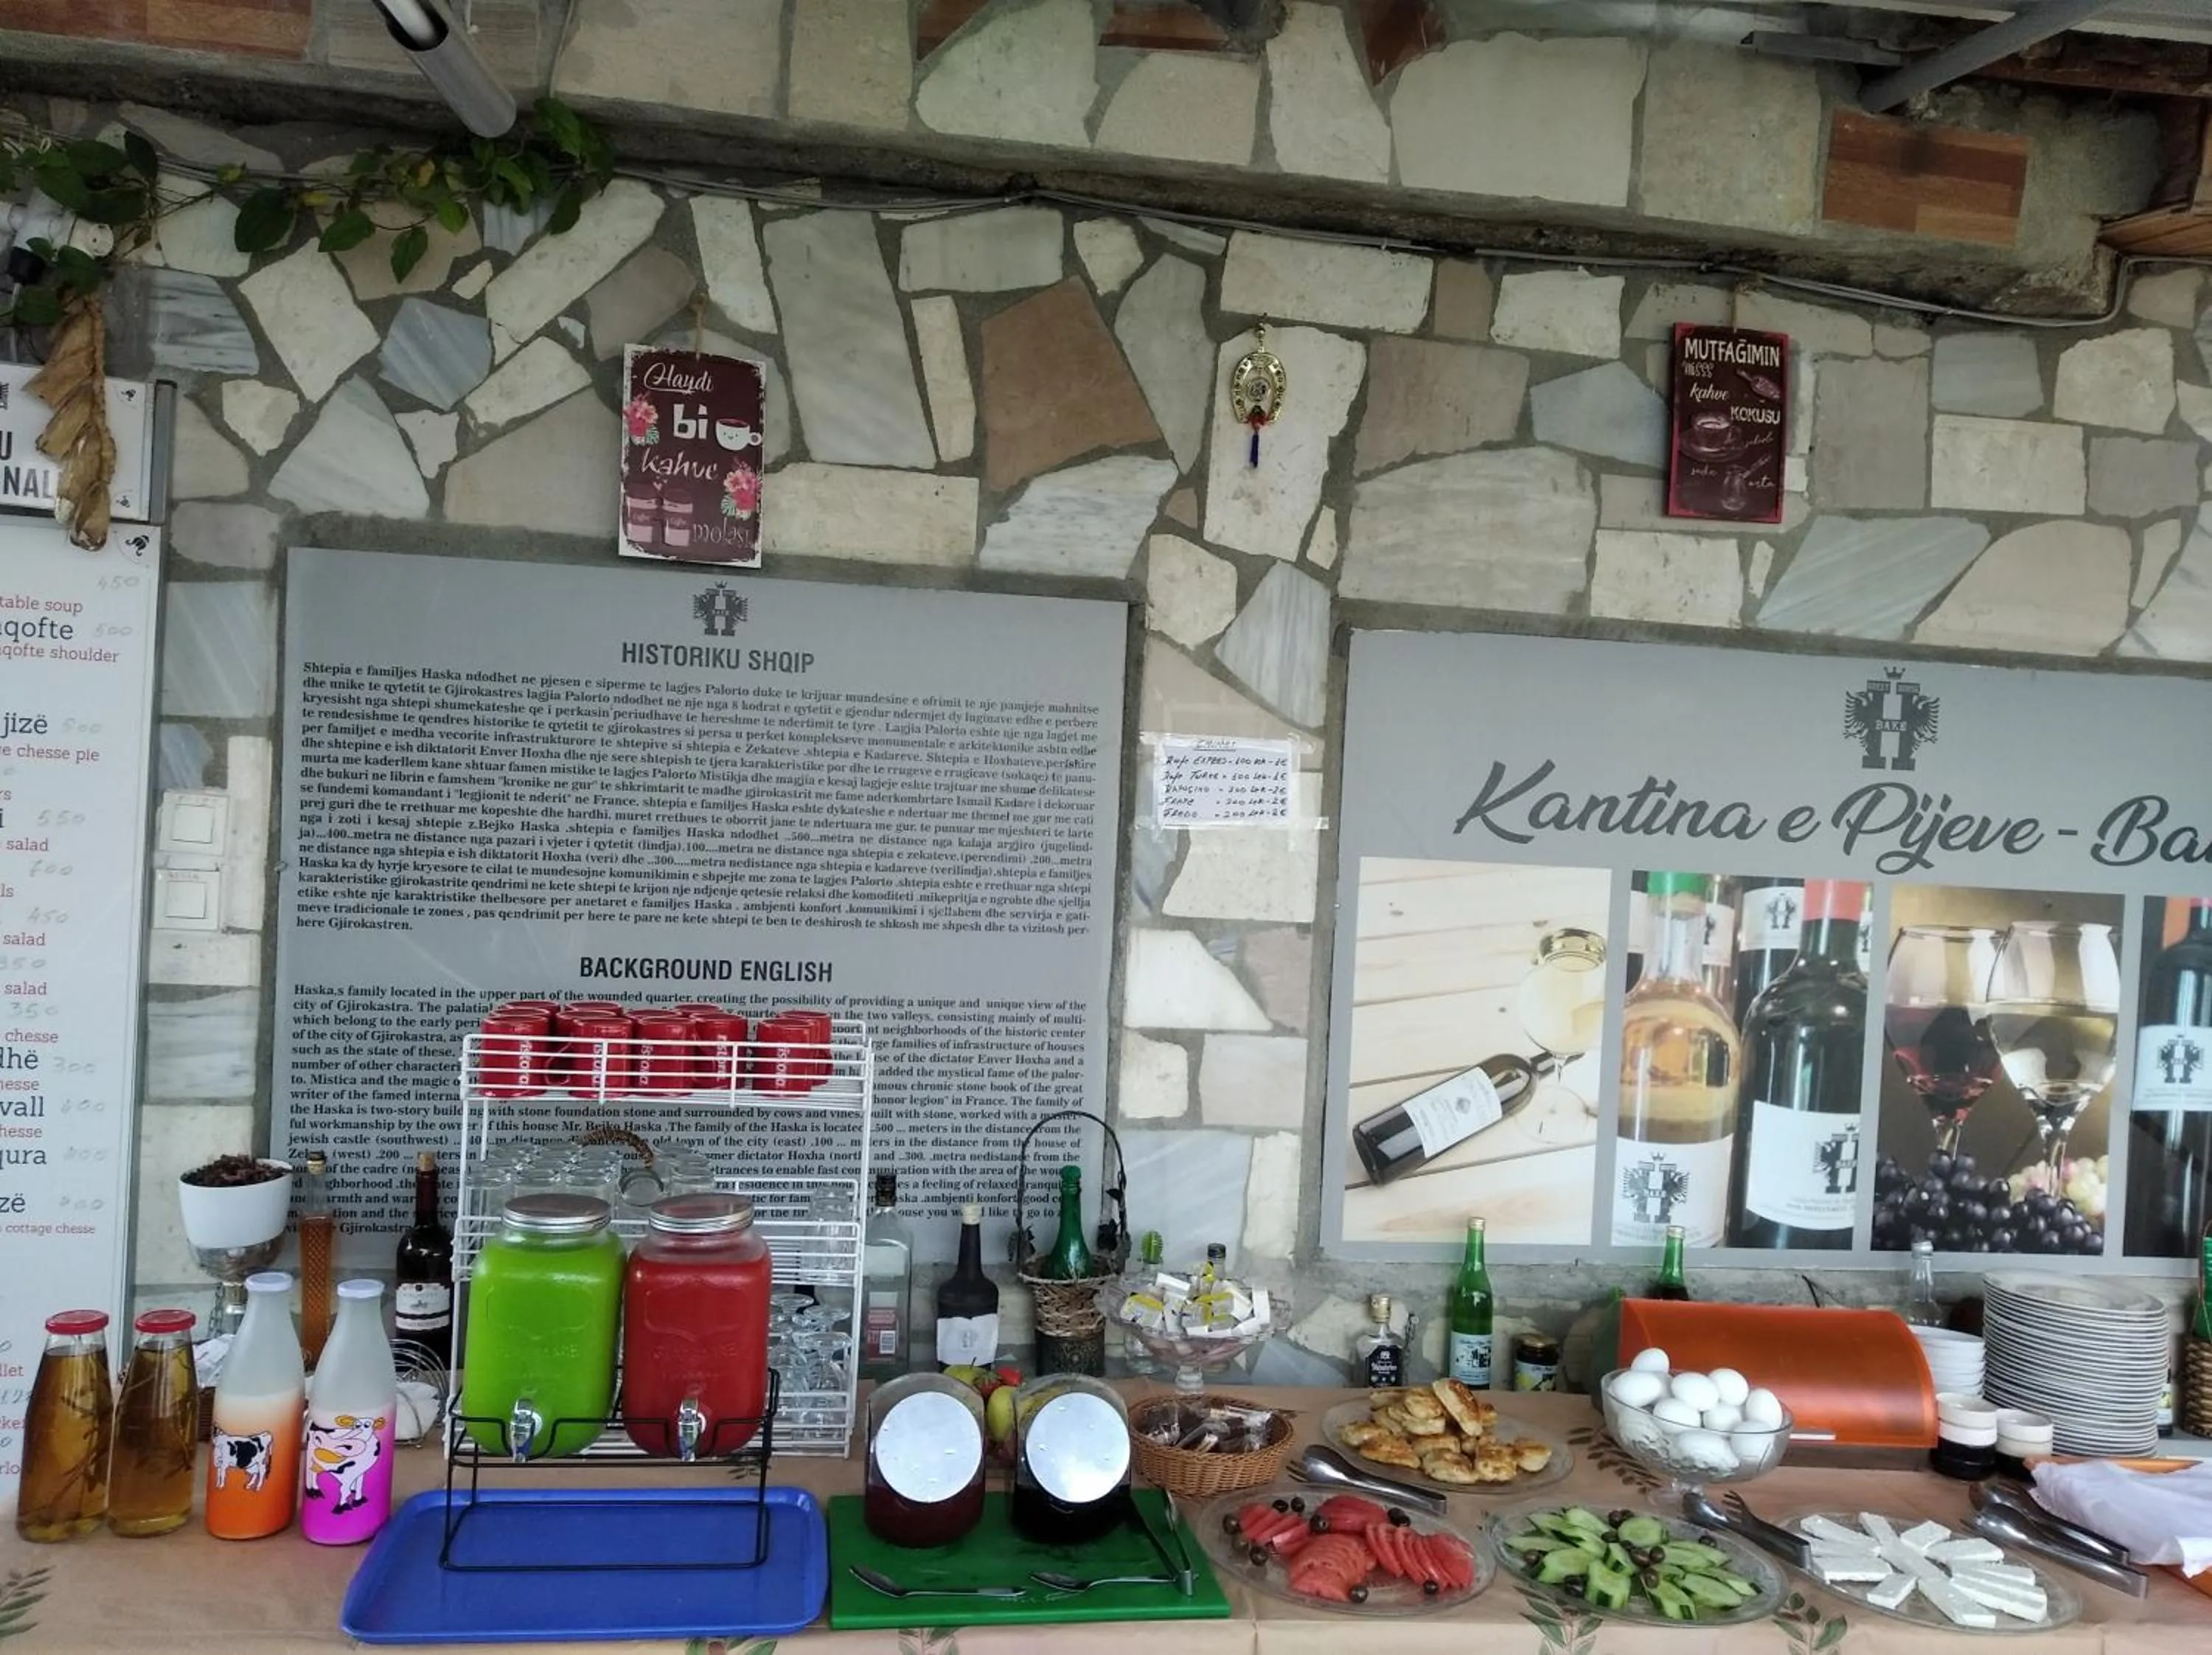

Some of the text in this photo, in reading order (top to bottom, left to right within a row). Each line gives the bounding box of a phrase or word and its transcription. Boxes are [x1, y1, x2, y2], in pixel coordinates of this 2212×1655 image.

[673, 403, 708, 440] bi
[641, 448, 719, 480] kahve
[44, 599, 83, 615] soup
[0, 617, 74, 642] qofte
[49, 645, 119, 663] shoulder
[622, 642, 815, 673] HISTORIKU SHQIP
[303, 662, 351, 678] Shtepia
[355, 667, 363, 675] e
[367, 665, 417, 681] familjes
[422, 667, 462, 680] Haska
[466, 670, 516, 684] ndodhet
[521, 676, 536, 684] ne
[540, 674, 580, 690] pjesen
[585, 679, 591, 687] e
[596, 676, 646, 693] siperme
[650, 679, 661, 691] te
[666, 681, 700, 696] lagjes
[705, 682, 749, 696] Palorto
[752, 685, 782, 698] duke
[786, 687, 796, 698] te
[801, 688, 842, 704] krijuar
[845, 690, 908, 705] mundesine
[913, 697, 919, 705] e
[965, 697, 975, 708] te
[980, 698, 995, 712] nje
[1, 712, 48, 738] jizë
[17, 743, 70, 760] chesse
[76, 747, 100, 764] pie
[1453, 758, 1768, 844] Kantina
[1777, 805, 1821, 843] e
[1832, 781, 2045, 875] Pijeve
[6, 837, 49, 853] salad
[299, 856, 338, 868] Haska
[341, 857, 356, 869] ka
[360, 858, 373, 872] dy
[378, 858, 408, 874] hyrje
[413, 860, 467, 875] kryesore
[471, 861, 482, 873] te
[486, 862, 512, 874] cilat
[516, 864, 528, 875] te
[531, 864, 605, 881] mundesojne
[609, 867, 689, 881] komunikimin
[692, 872, 699, 881] e
[702, 870, 745, 885] shpejte
[748, 874, 765, 883] me
[770, 875, 796, 884] zona
[799, 872, 810, 884] te
[814, 873, 846, 888] lagjes
[851, 874, 892, 887] Palorto
[942, 877, 973, 889] eshte
[975, 881, 981, 889] e
[1035, 884, 1054, 895] nga
[1057, 881, 1091, 896] shtepi
[296, 916, 411, 932] here Gjirokastren.
[3, 931, 46, 947] salad
[580, 956, 833, 982] BACKGROUND ENGLISH
[4, 981, 48, 996] salad
[348, 985, 386, 999] family
[391, 985, 436, 997] located
[440, 986, 451, 998] in
[456, 987, 475, 998] the
[479, 990, 516, 1002] upper
[520, 988, 546, 1003] part
[549, 989, 562, 1000] of
[564, 989, 584, 1001] the
[587, 990, 641, 1002] wounded
[697, 991, 746, 1007] creating
[750, 993, 768, 1004] the
[772, 993, 832, 1008] possibility
[835, 994, 847, 1005] of
[849, 994, 904, 1009] providing
[907, 999, 913, 1007] a
[917, 996, 956, 1010] unique
[959, 996, 979, 1008] and
[987, 997, 1023, 1012] unique
[1029, 998, 1051, 1010] view
[1056, 999, 1066, 1010] of
[1069, 999, 1085, 1010] the
[293, 999, 316, 1013] city
[320, 999, 333, 1010] of
[337, 999, 411, 1015] Gjirokastra.
[417, 1001, 441, 1012] The
[845, 1009, 866, 1020] the
[865, 1009, 888, 1020] two
[938, 1010, 994, 1025] consisting
[998, 1011, 1035, 1026] mainly
[1040, 1012, 1051, 1023] of
[5, 1028, 60, 1044] chesse
[5, 1224, 96, 1236] cottage chesse
